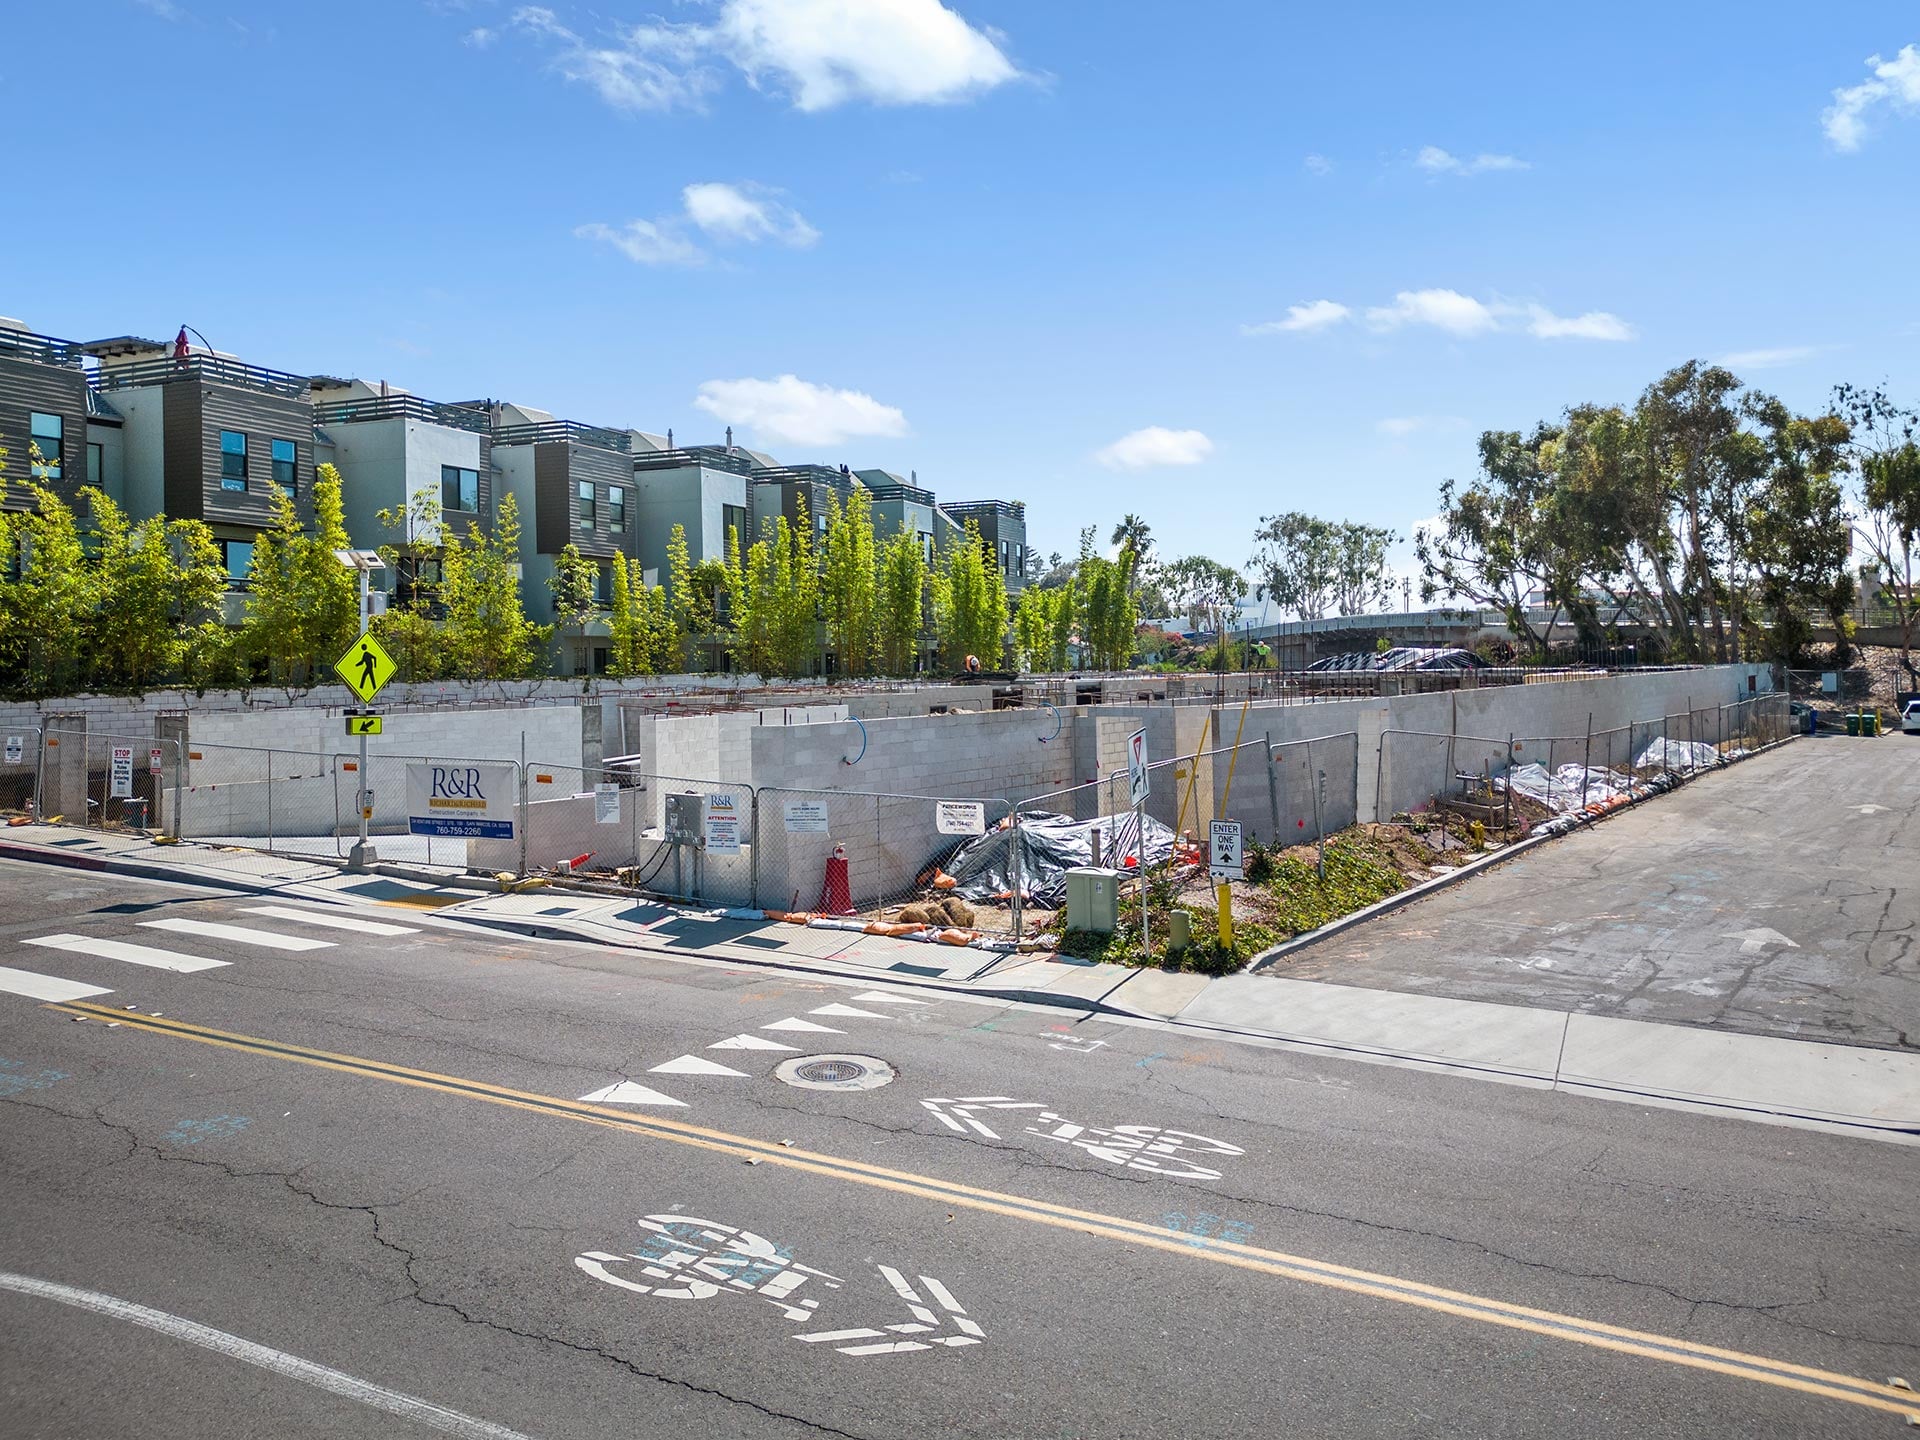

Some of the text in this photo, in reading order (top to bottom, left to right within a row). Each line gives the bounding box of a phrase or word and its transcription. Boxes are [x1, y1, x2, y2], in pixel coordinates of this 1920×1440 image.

[114, 749, 130, 757] STOP
[430, 767, 486, 799] R&R
[711, 795, 732, 806] R&R
[436, 826, 482, 836] 760-759-2260
[1213, 825, 1238, 834] ENTER
[1218, 836, 1235, 844] ONE
[1217, 844, 1235, 852] WAY
